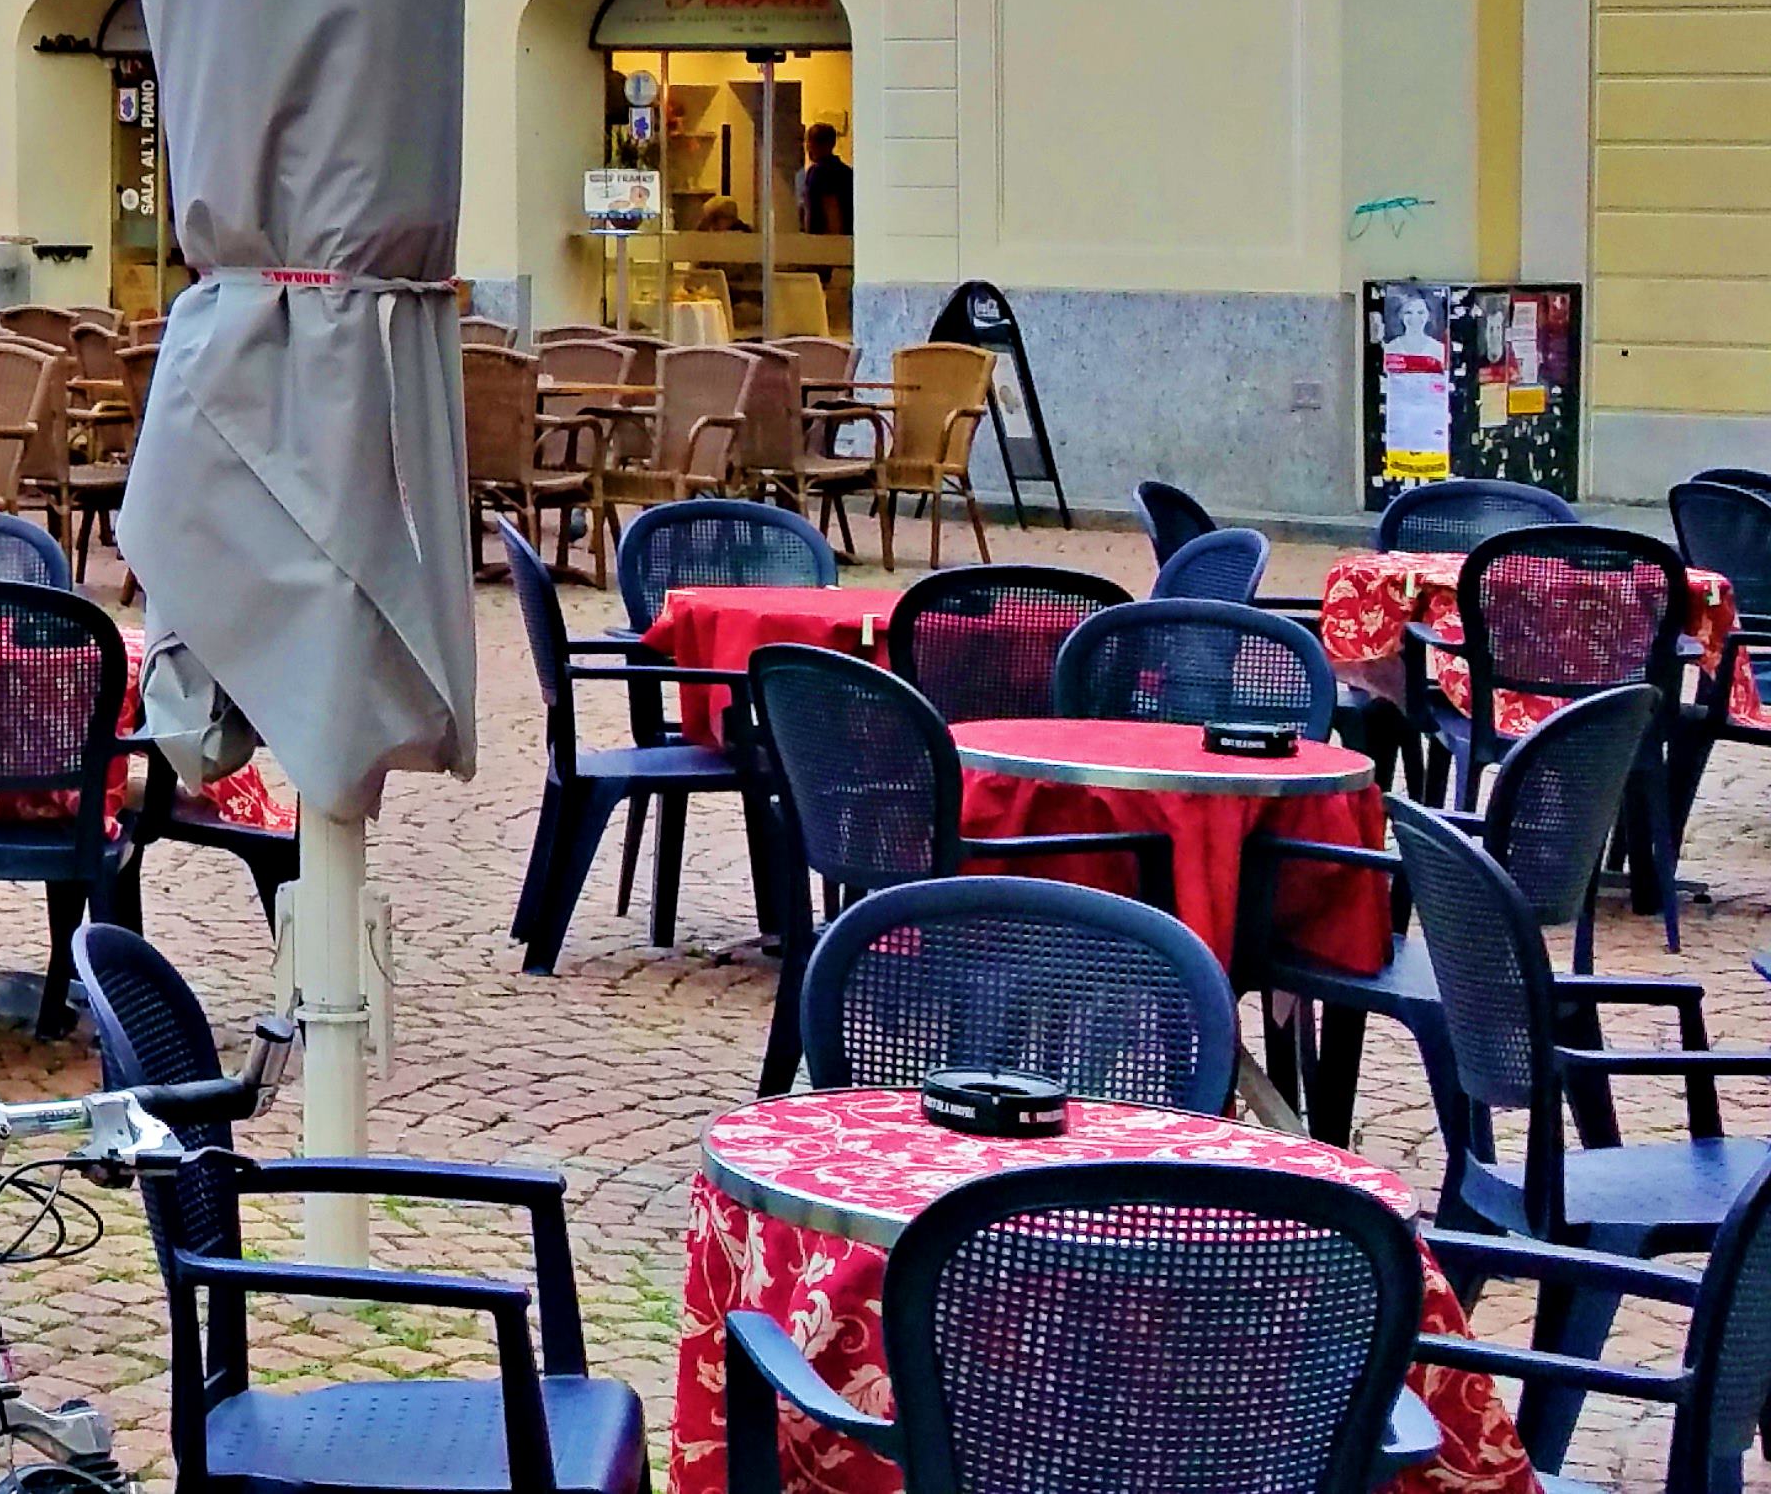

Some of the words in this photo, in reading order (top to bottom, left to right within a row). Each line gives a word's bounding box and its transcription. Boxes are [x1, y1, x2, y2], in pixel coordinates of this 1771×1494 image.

[141, 80, 156, 128] PIANO
[141, 148, 155, 168] AL
[140, 173, 155, 215] SALA
